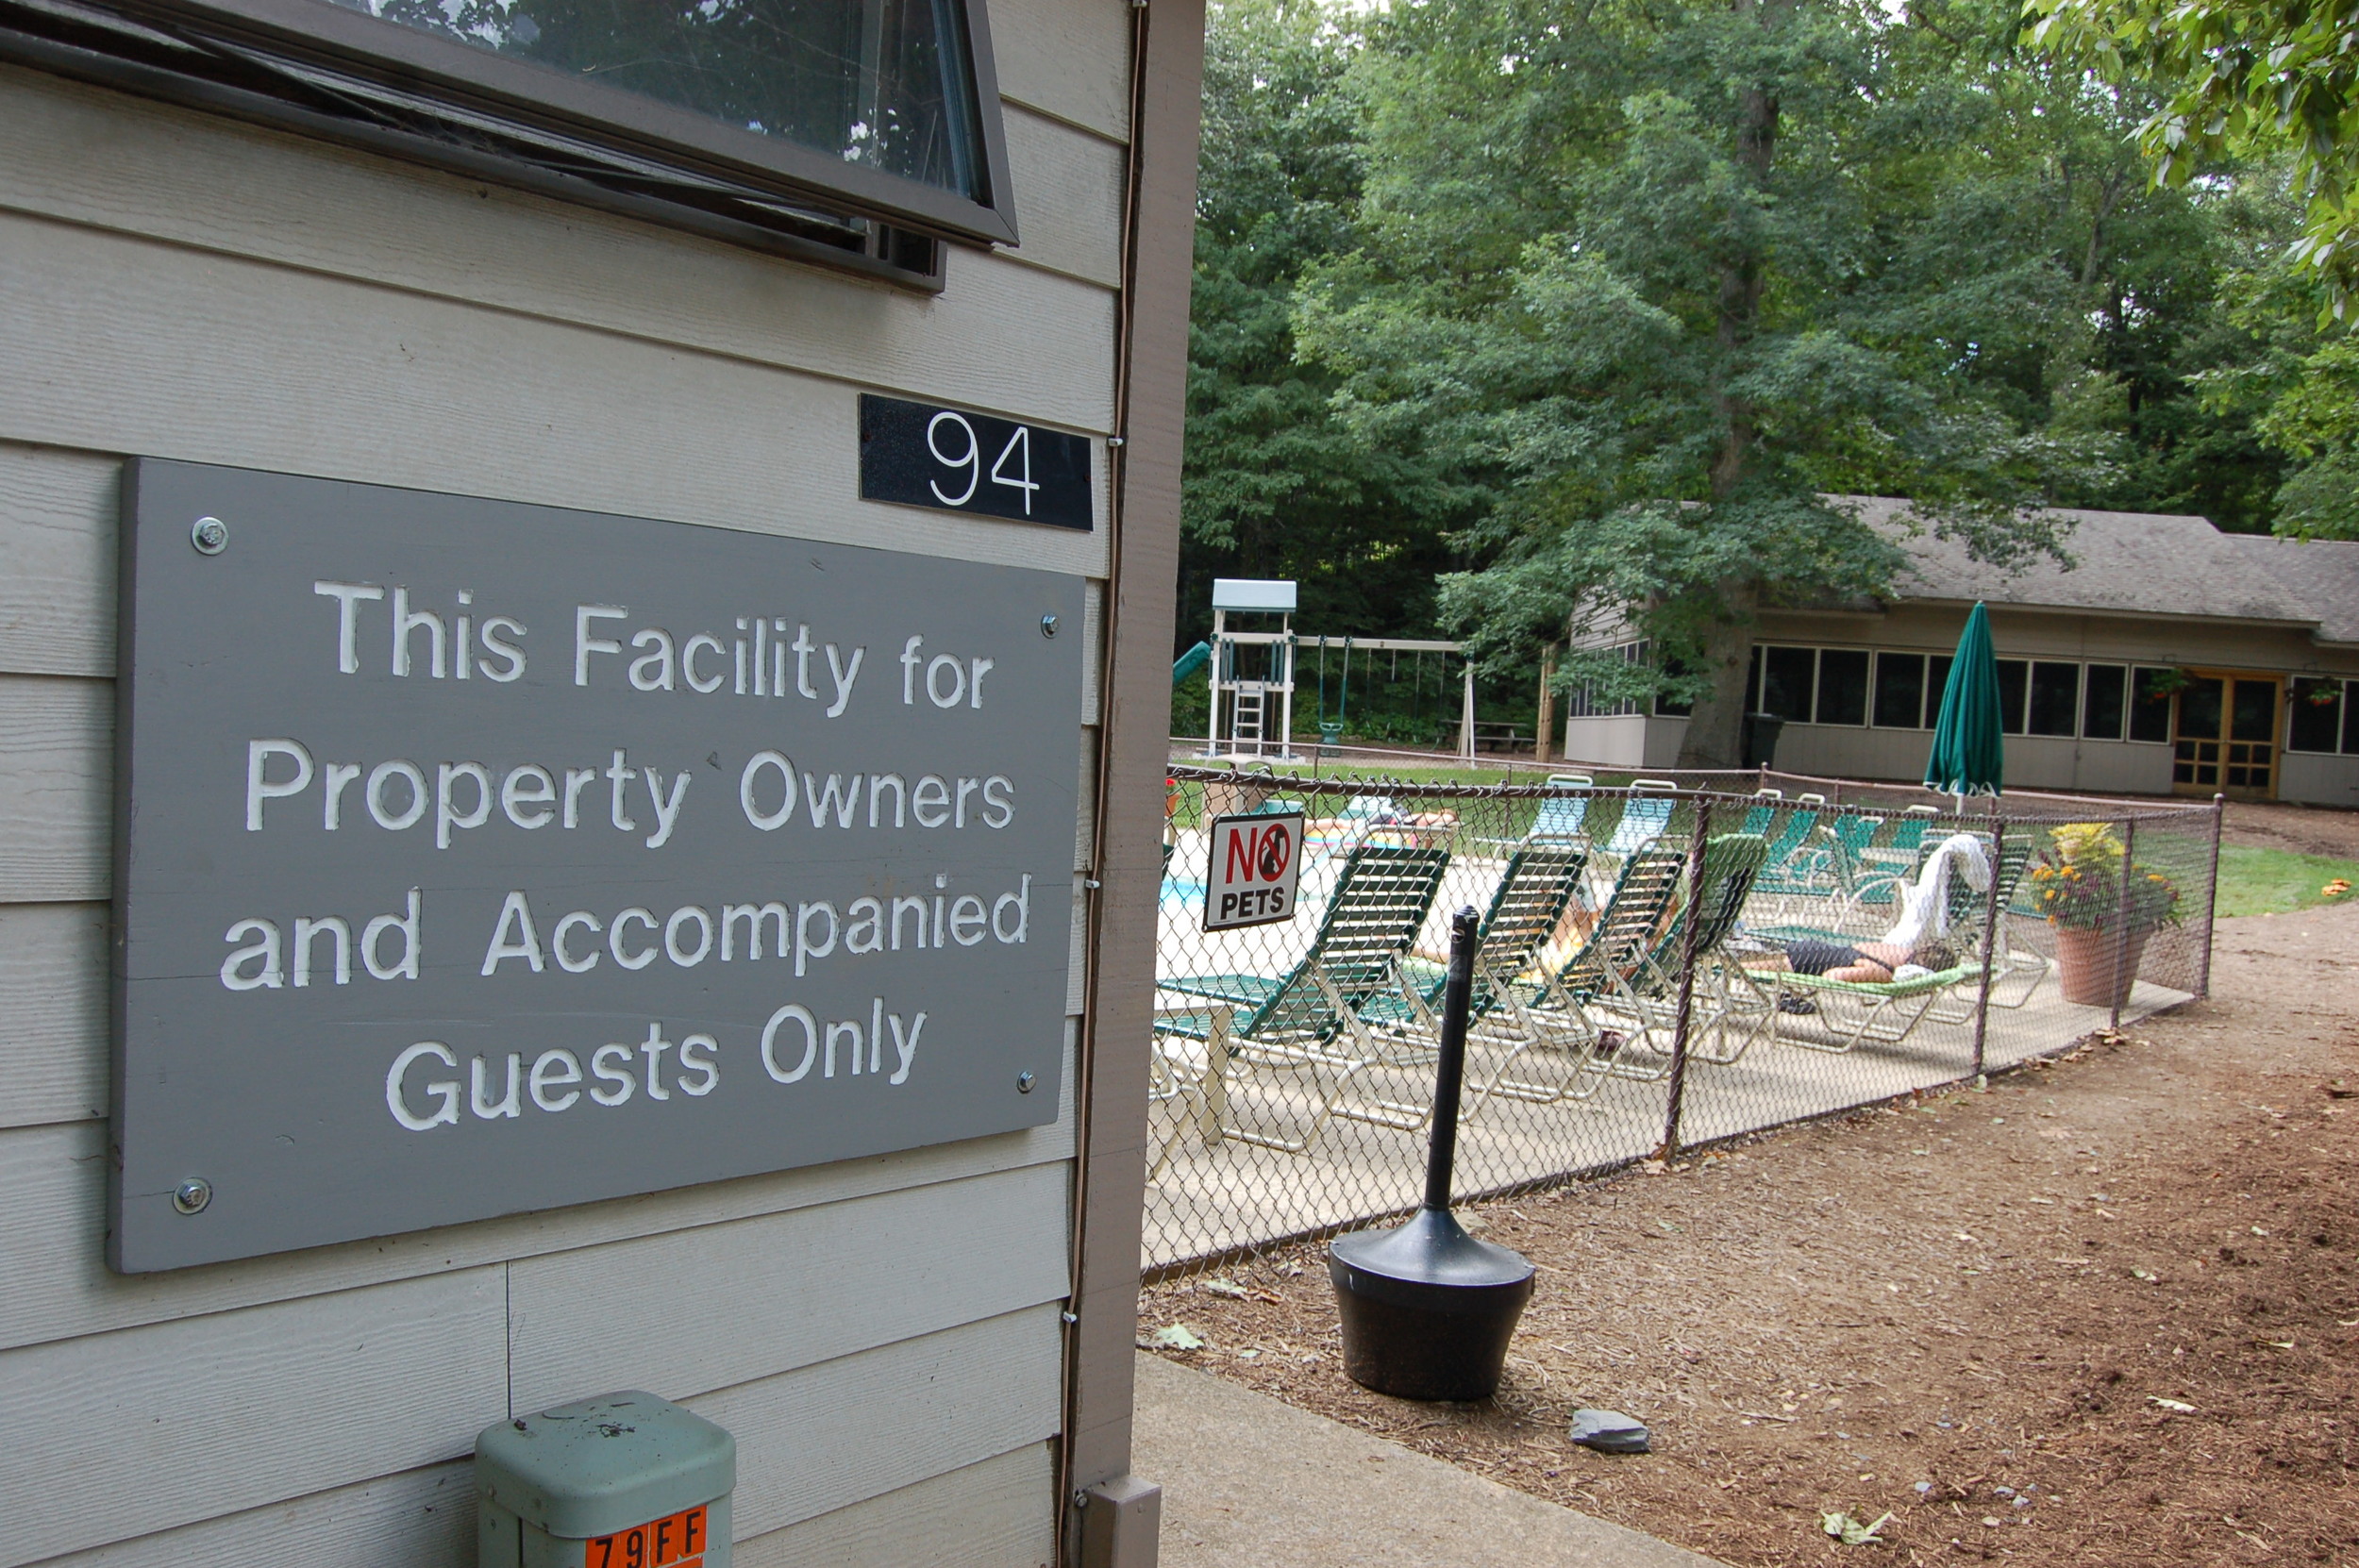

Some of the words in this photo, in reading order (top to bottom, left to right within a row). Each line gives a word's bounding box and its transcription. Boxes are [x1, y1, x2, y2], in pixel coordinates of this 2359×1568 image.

[926, 410, 1041, 516] 94
[314, 580, 527, 683] This
[574, 604, 864, 718] Facility
[898, 634, 995, 709] for
[245, 739, 692, 849] Property
[739, 749, 1015, 832] Owners
[1220, 886, 1285, 921] PETS
[1225, 823, 1291, 885] NO
[220, 885, 422, 991] and
[479, 872, 1031, 978] Accompanied
[385, 1019, 719, 1132] Guests
[760, 996, 928, 1086] Only
[595, 1510, 701, 1568] 79FF
